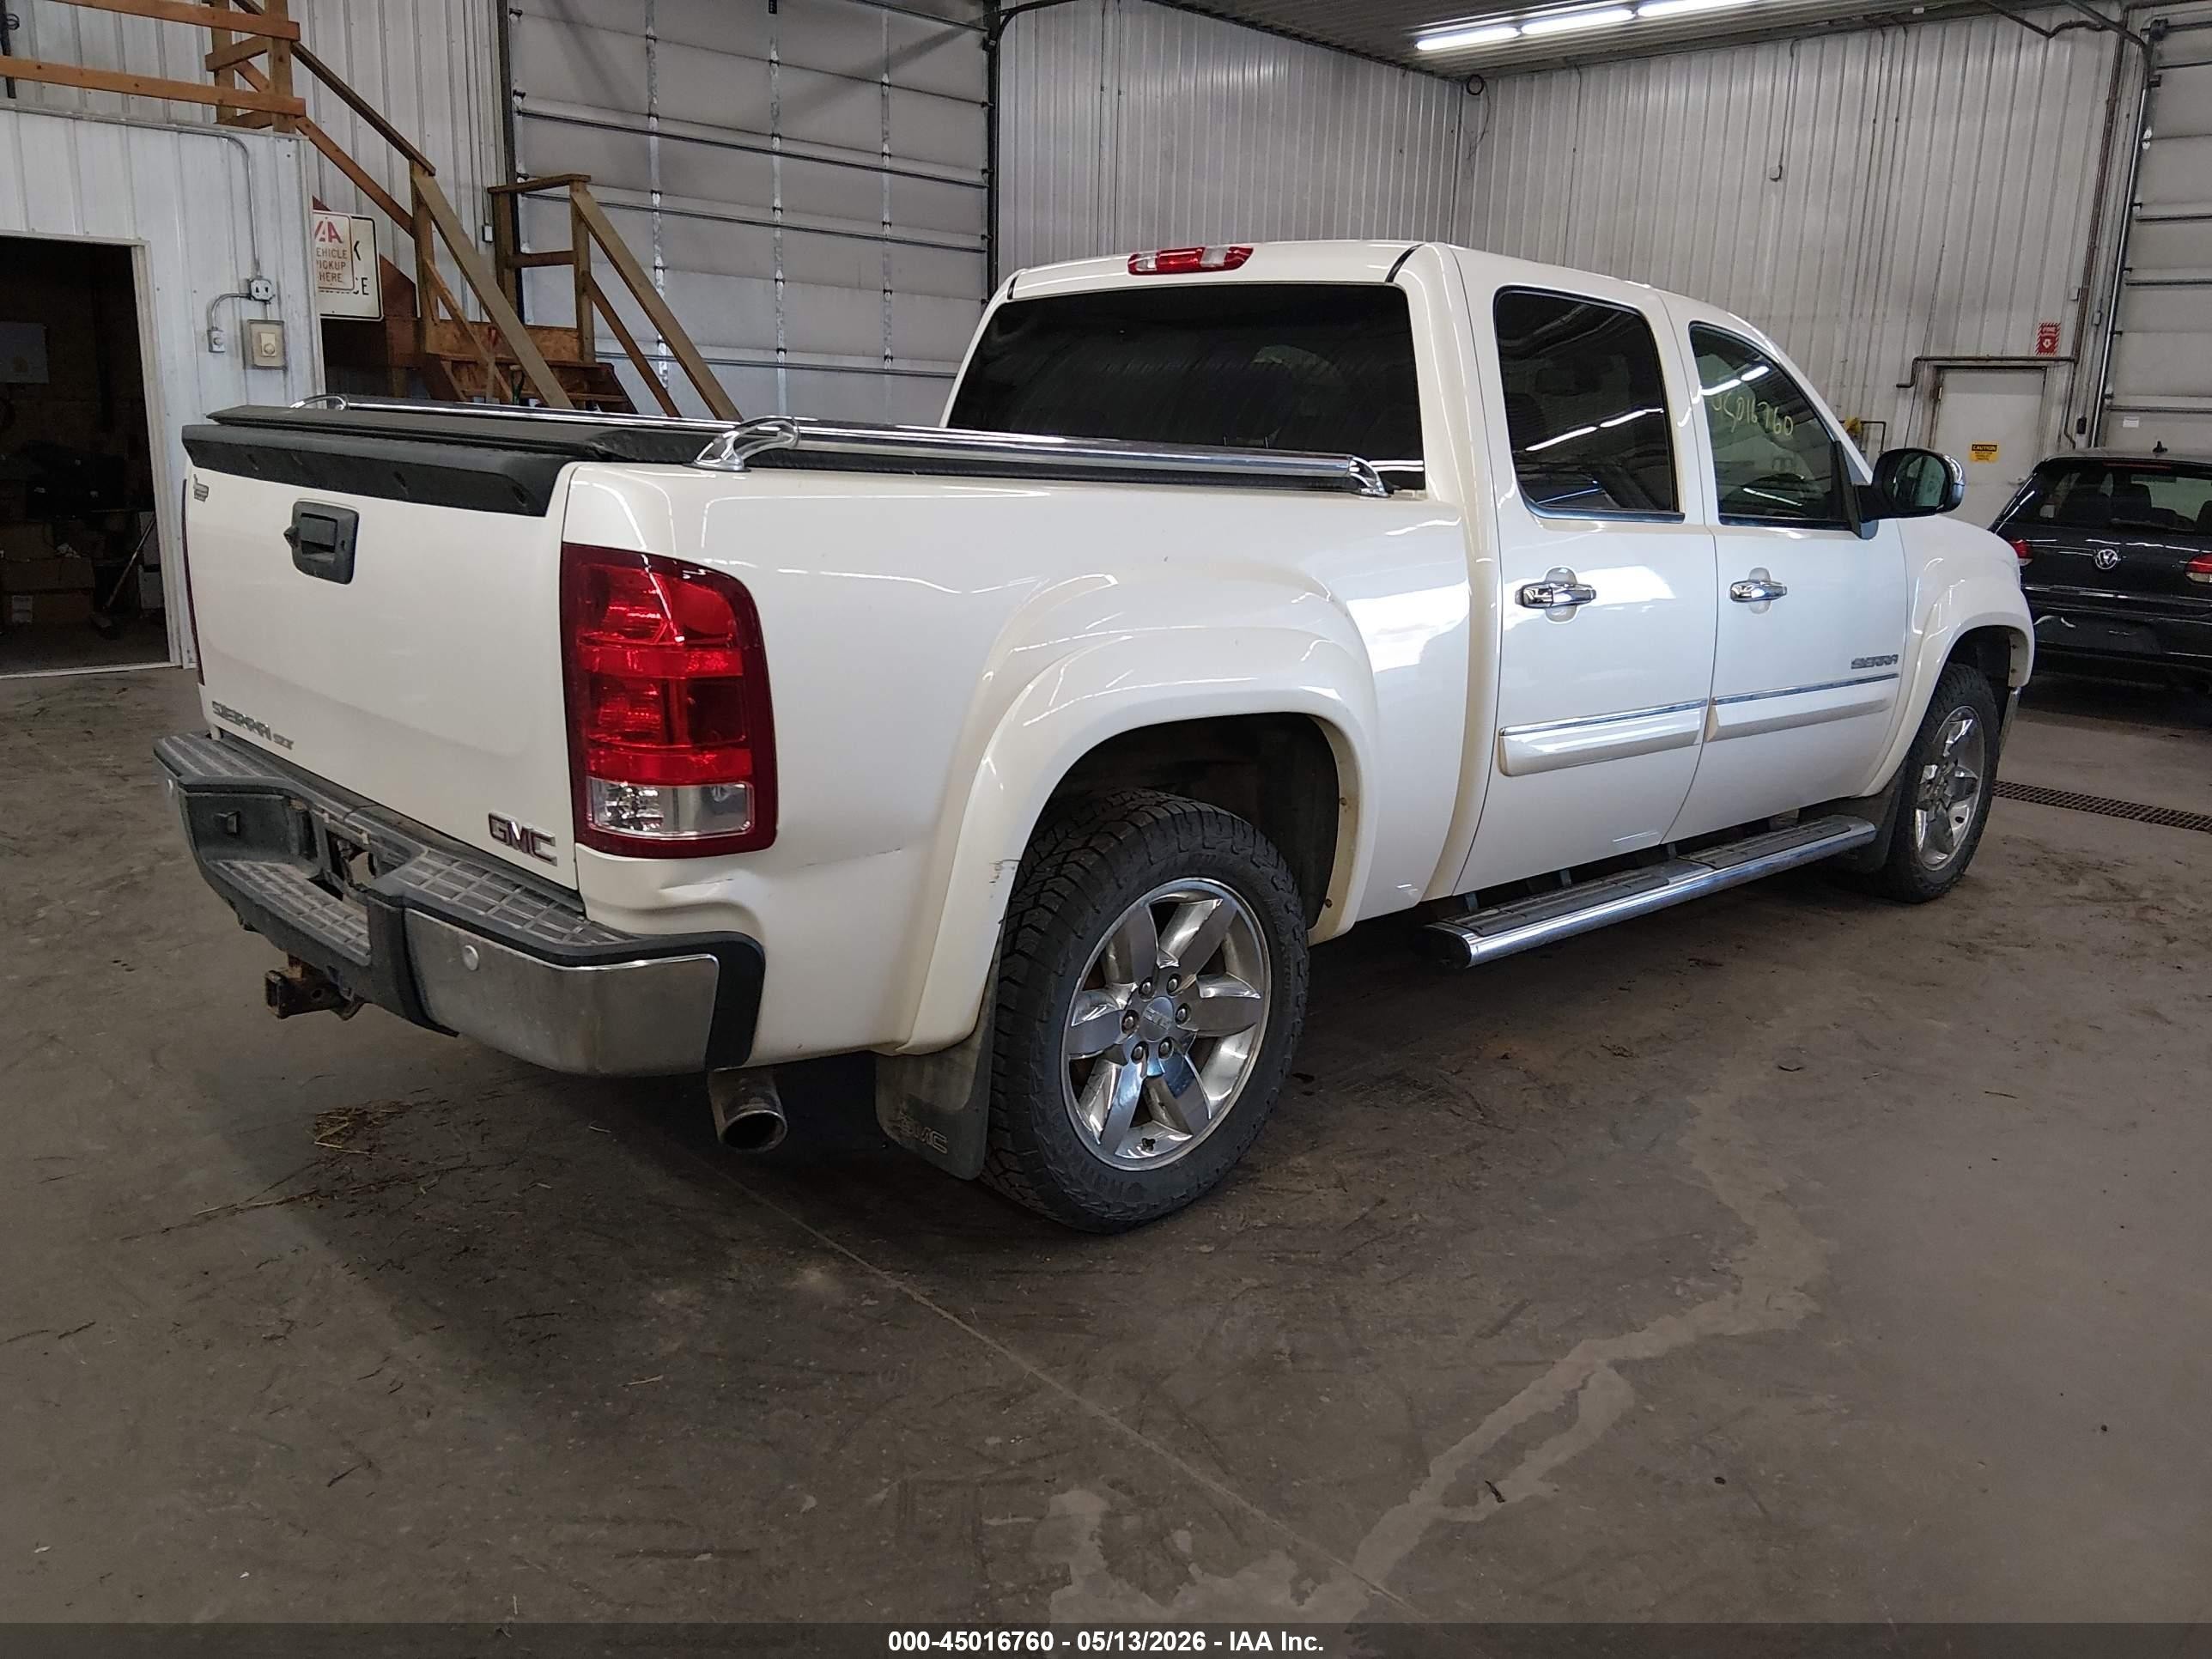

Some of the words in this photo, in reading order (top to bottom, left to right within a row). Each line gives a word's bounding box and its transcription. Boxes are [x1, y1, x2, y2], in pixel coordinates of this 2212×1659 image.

[316, 247, 348, 259] EHICLE
[316, 260, 347, 270] ICKUP
[319, 271, 343, 283] HERE
[1850, 653, 1899, 670] SIERRA
[211, 700, 271, 741] SIERRA
[488, 811, 558, 867] GMC
